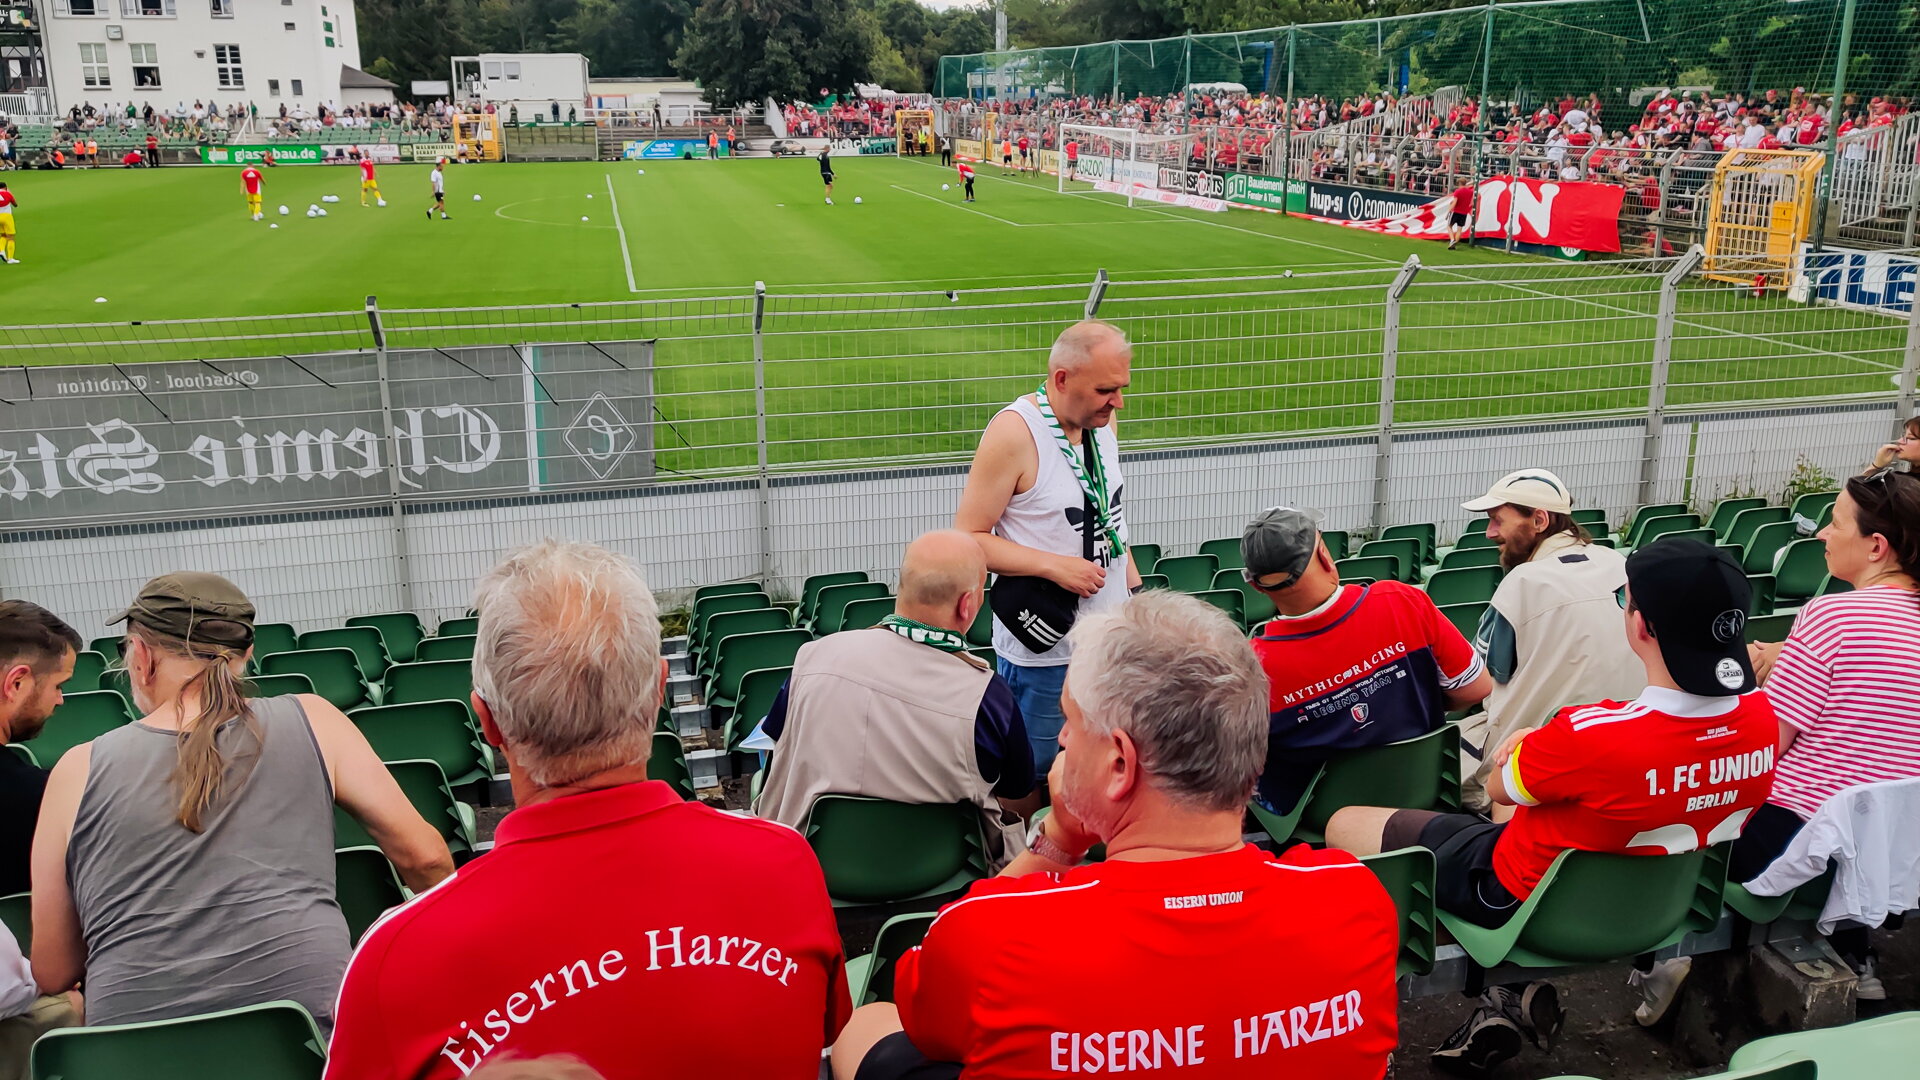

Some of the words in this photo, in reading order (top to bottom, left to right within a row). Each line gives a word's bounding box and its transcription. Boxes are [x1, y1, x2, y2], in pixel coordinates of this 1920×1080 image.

[234, 147, 317, 163] glasbau.de
[1073, 158, 1104, 177] GAZOO
[1248, 175, 1285, 192] Bauelement
[1287, 180, 1306, 195] GmbH
[1283, 673, 1344, 705] MYTHIC
[1351, 641, 1407, 675] RACING
[1354, 677, 1374, 689] WORLD
[1313, 692, 1360, 718] LEGEND
[1361, 675, 1392, 698] TEAM
[1645, 768, 1666, 796] 1.
[1673, 763, 1702, 793] FC
[1709, 744, 1775, 785] UNION
[1685, 789, 1739, 813] BERLIN
[1163, 893, 1207, 910] EISERN
[1208, 890, 1244, 907] UNION
[439, 949, 627, 1078] Eiserne
[644, 926, 799, 987] Harzer
[1050, 1024, 1206, 1074] EISERNE
[1233, 989, 1364, 1059] HARZER
